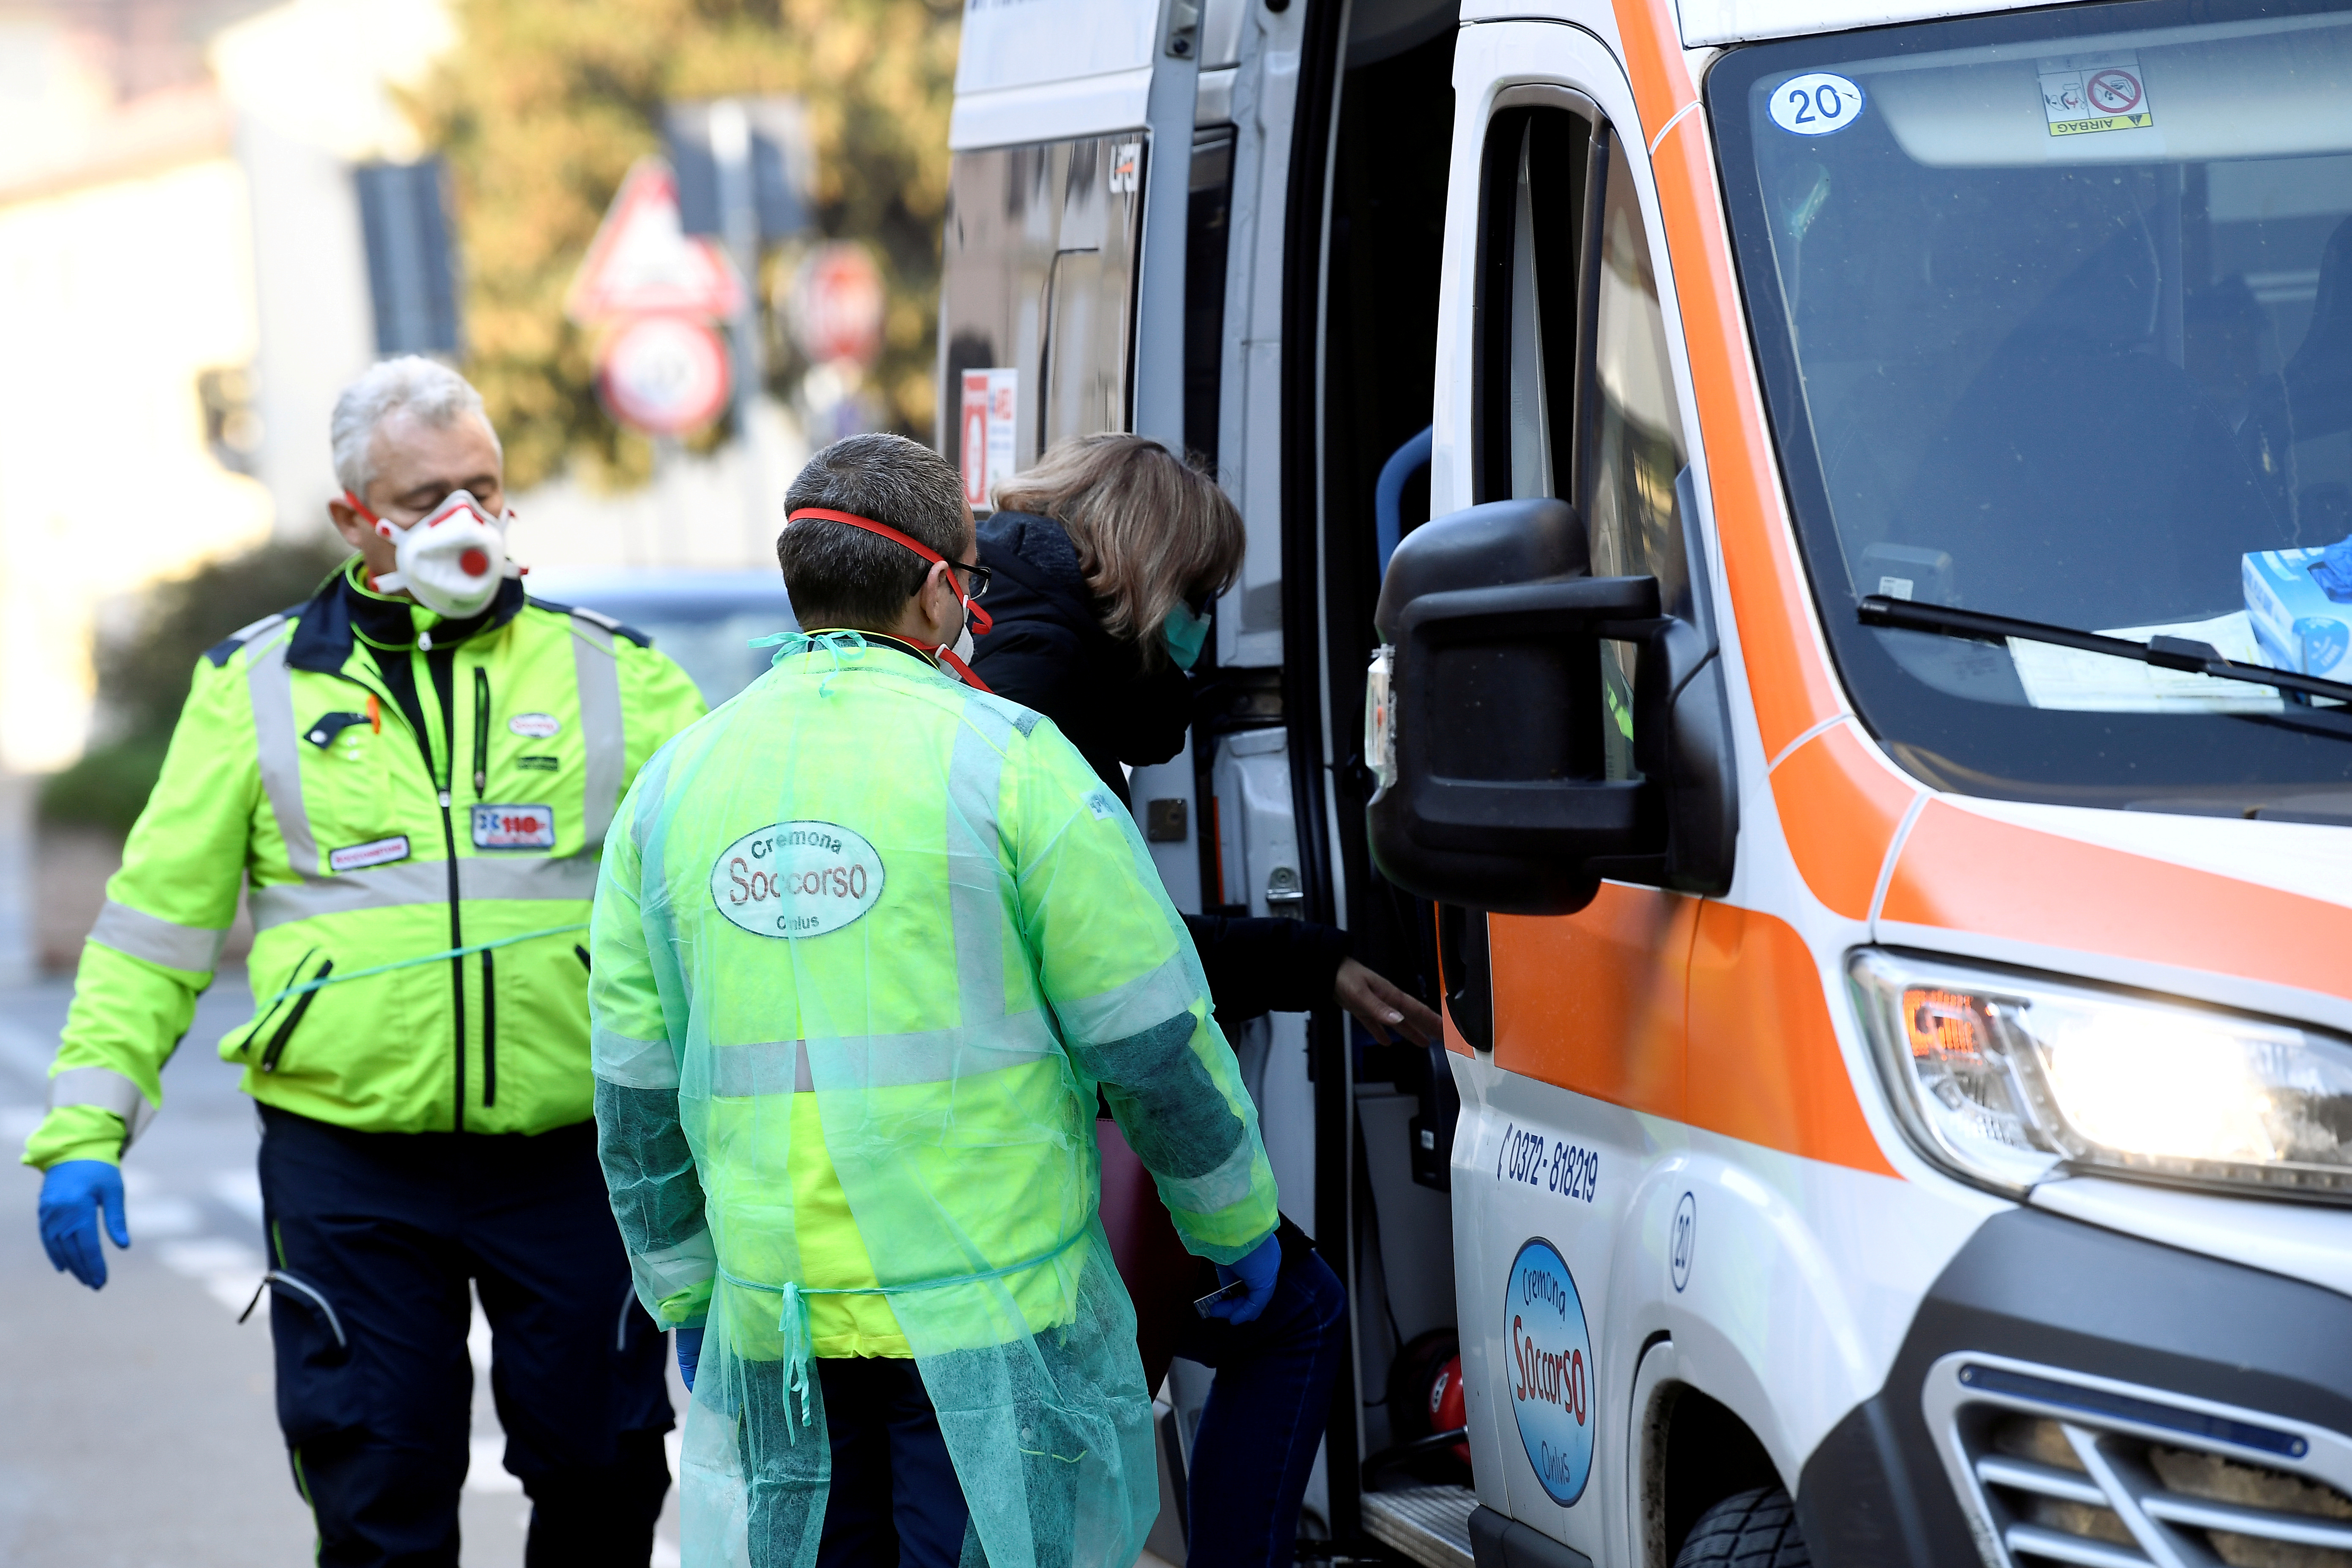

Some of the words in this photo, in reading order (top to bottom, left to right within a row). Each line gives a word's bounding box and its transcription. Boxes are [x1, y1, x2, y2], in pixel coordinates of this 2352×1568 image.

[1789, 84, 1841, 124] 20
[2058, 119, 2113, 132] AIRBAG
[751, 830, 842, 859] Cremona
[729, 857, 867, 906] Soccorso
[776, 915, 819, 931] Onlus
[1675, 1214, 1690, 1269] 20
[1513, 1315, 1586, 1427] Soccorso
[1541, 1440, 1571, 1485] Onlus
